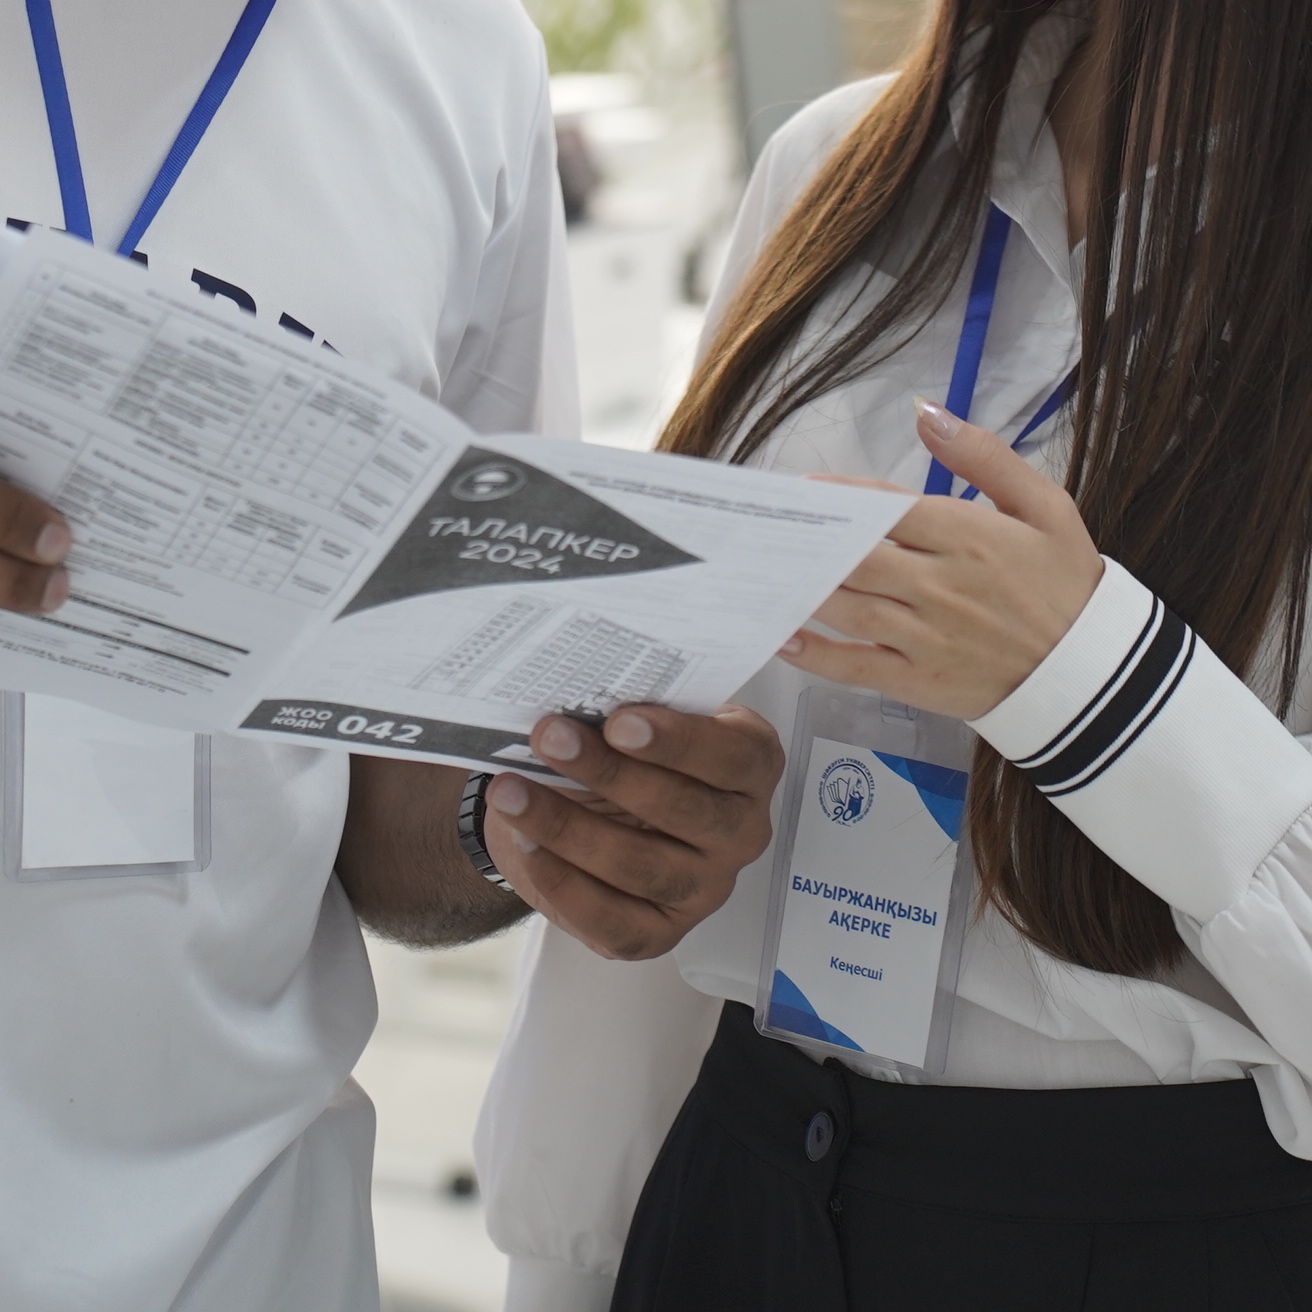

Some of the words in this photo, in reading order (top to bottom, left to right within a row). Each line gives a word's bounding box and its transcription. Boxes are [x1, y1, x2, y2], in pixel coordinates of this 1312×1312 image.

[427, 516, 641, 564] ТАЛАПКЕР
[459, 540, 564, 576] 2024
[277, 705, 333, 721] ЖОО
[336, 714, 424, 744] 042
[831, 805, 854, 822] 90
[791, 875, 938, 927] БАУЫРЖАНҚЫЗЫ
[828, 910, 892, 940] АҚЕРКЕ
[829, 956, 884, 982] Кеңесші
